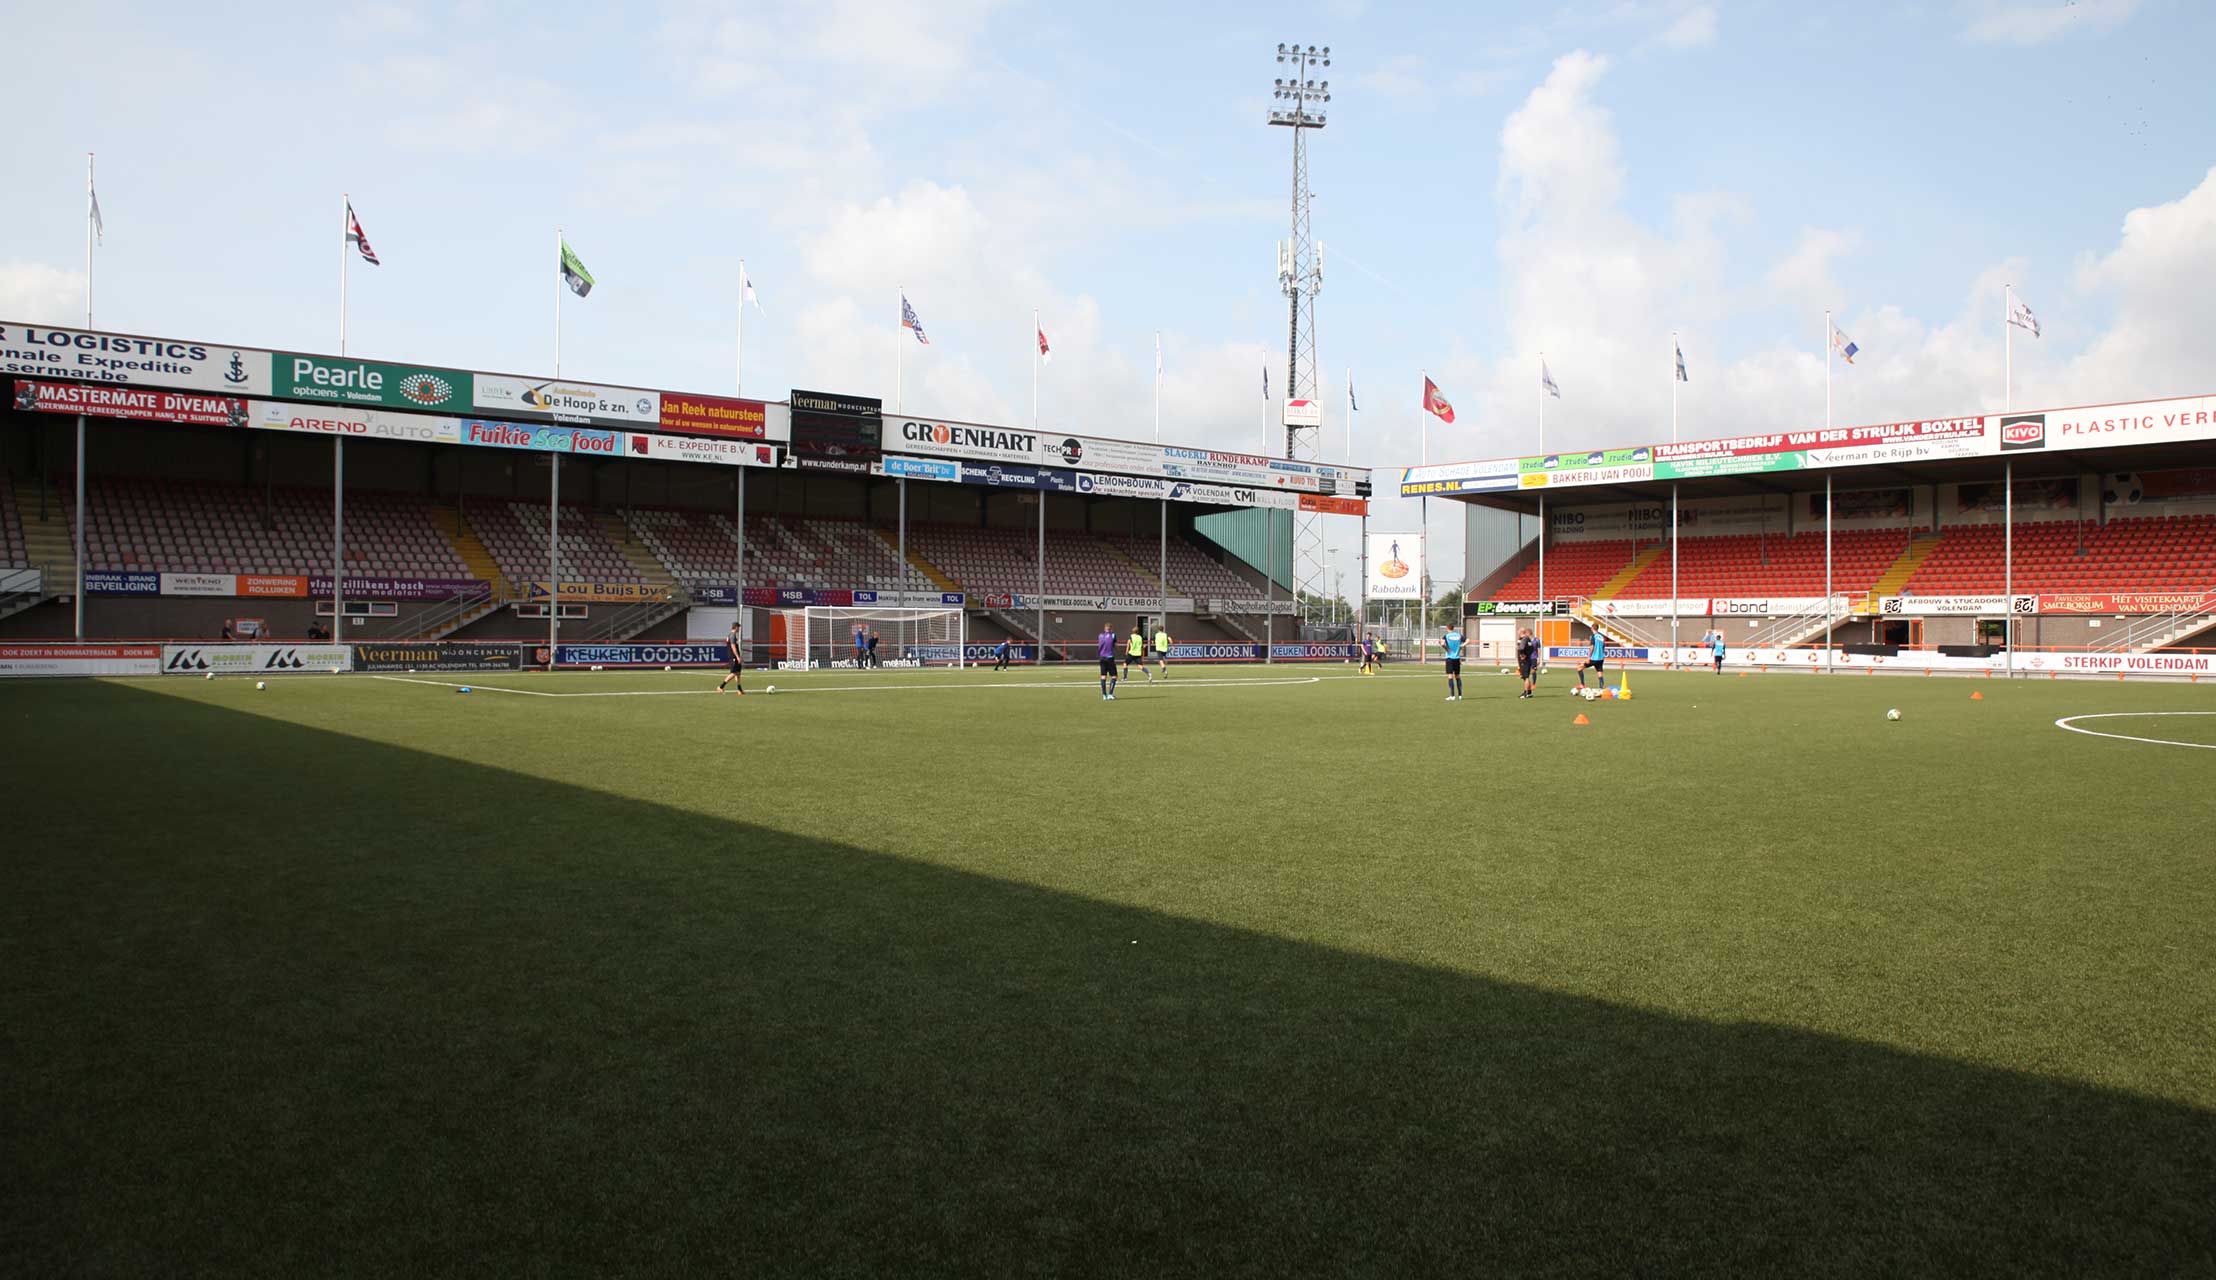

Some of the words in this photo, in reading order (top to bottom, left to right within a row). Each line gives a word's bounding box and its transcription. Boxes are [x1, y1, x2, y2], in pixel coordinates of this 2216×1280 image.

[27, 329, 208, 361] LOGISTICS
[78, 353, 192, 375] Expeditie
[293, 358, 383, 391] Pearle
[39, 385, 157, 410] MASTERMATE
[165, 396, 228, 415] DIVEMA
[293, 386, 339, 398] opticiens
[346, 391, 382, 402] Volendam
[544, 394, 560, 407] De
[563, 395, 596, 413] Hoop
[599, 400, 608, 411] &
[611, 403, 629, 414] zn.
[791, 392, 838, 411] Veerman
[838, 402, 882, 412] WOONCENTRUM
[87, 406, 152, 417] GEREEDSCHAPPEN
[190, 414, 229, 423] SLUITWERK
[661, 400, 679, 415] Jan
[688, 402, 706, 417] Reek
[708, 405, 764, 422] natuursteen
[553, 413, 591, 424] Volendam
[2062, 416, 2153, 435] PLASTIC
[2164, 410, 2216, 427] VER
[290, 416, 367, 434] AREND
[375, 424, 433, 439] AUTO
[2006, 425, 2039, 438] KIVO
[469, 424, 531, 446] Fuikie
[535, 427, 616, 452] Seafood
[1655, 435, 1783, 457] TRANSPORTBEDRIJF
[1788, 432, 1817, 446] VAN
[1820, 429, 1848, 443] DER
[1852, 423, 1915, 440] STRUIJK
[1920, 416, 1983, 434] BOXTEL
[658, 438, 676, 449] K.E.
[679, 440, 727, 453] EXPEDITIE
[730, 445, 747, 455] B.V.
[1043, 444, 1082, 457] TECHPROF
[1873, 448, 1888, 459] De
[1891, 446, 1913, 459] Rijp
[1916, 446, 1930, 456] bv
[1164, 447, 1208, 461] SLAGERIJ
[1209, 452, 1270, 468] RUNDERKAMP
[801, 457, 868, 473] www.runderkamp.nl
[890, 461, 901, 471] de
[903, 461, 922, 472] Boer
[1197, 460, 1238, 469] HAVENHOF
[1415, 467, 1436, 480] AUTO
[1438, 464, 1471, 478] SCHADE
[1473, 461, 1517, 475] VOLENDAM
[961, 467, 987, 477] SCHENK
[1001, 473, 1036, 485] RECYCLING
[1552, 469, 1598, 485] BAKKERIJ
[1601, 467, 1620, 481] VAN
[1623, 465, 1652, 479] POOIJ
[1307, 477, 1317, 487] TOL
[1402, 481, 1462, 495] RENES.NL
[1193, 487, 1231, 498] VOLENDAM
[1234, 489, 1256, 503] CMI
[1553, 512, 1585, 525] NIBO
[1629, 507, 1661, 521] NIBO
[86, 574, 122, 582] INBRAAK
[175, 576, 222, 585] WESTEND
[247, 578, 297, 586] ZONWERING
[86, 581, 157, 592] BEVEILIGING
[249, 586, 296, 594] ROLLUIKEN
[343, 580, 391, 590] zillikens
[394, 580, 424, 590] bosch
[557, 583, 588, 594] Lou
[593, 583, 634, 596] Buijs
[639, 584, 659, 595] bv
[1371, 583, 1417, 594] Rabobank
[372, 588, 422, 596] mediators
[702, 589, 724, 598] HSB
[782, 591, 803, 599] HSB
[859, 592, 872, 600] TOL
[946, 594, 959, 602] TOL
[1729, 600, 1768, 613] bond
[1953, 597, 2008, 605] STUCADOORS
[2112, 595, 2132, 604] HET
[2134, 595, 2206, 605] VISITEKAARTJE
[1477, 602, 1496, 613] EP:
[1495, 601, 1553, 615] Beerepoot
[2118, 604, 2138, 612] VAN
[357, 646, 440, 662] Veerman
[566, 647, 722, 662] KEUKENLOODS.NL
[1167, 645, 1257, 658] KEUKENLOODS.NL
[1272, 645, 1351, 657] KEUKENLOODS.NL
[2064, 656, 2122, 669] STERKIP
[2128, 657, 2209, 670] VOLENDAM
